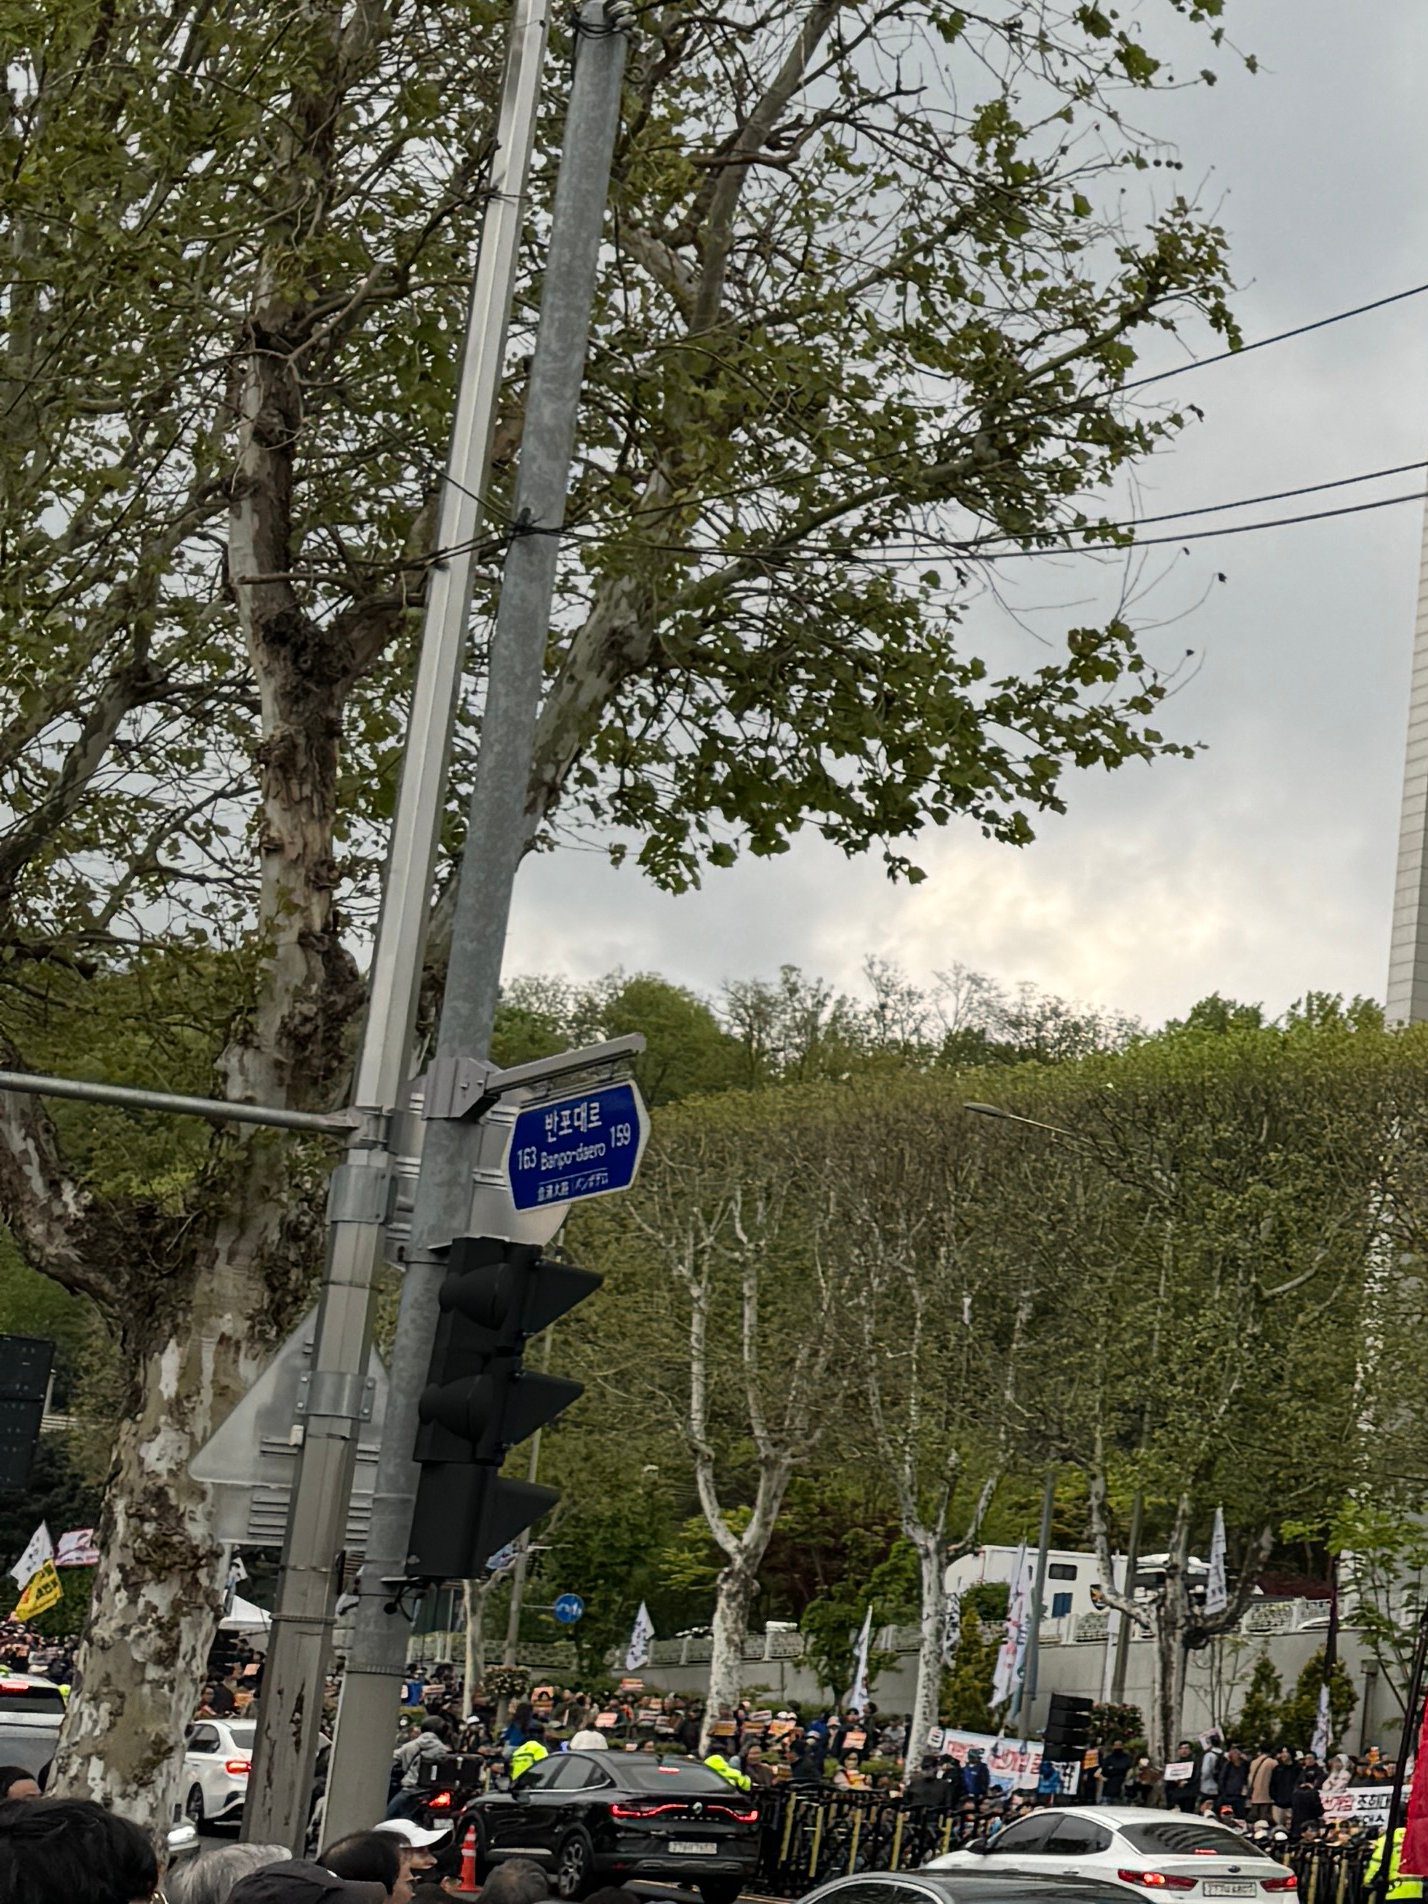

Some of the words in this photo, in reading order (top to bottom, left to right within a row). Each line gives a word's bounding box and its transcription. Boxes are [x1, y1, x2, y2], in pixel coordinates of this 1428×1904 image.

[544, 1102, 603, 1143] 반포대로
[517, 1146, 537, 1170] 163
[541, 1142, 606, 1171] Banpo-daero
[610, 1122, 631, 1148] 159
